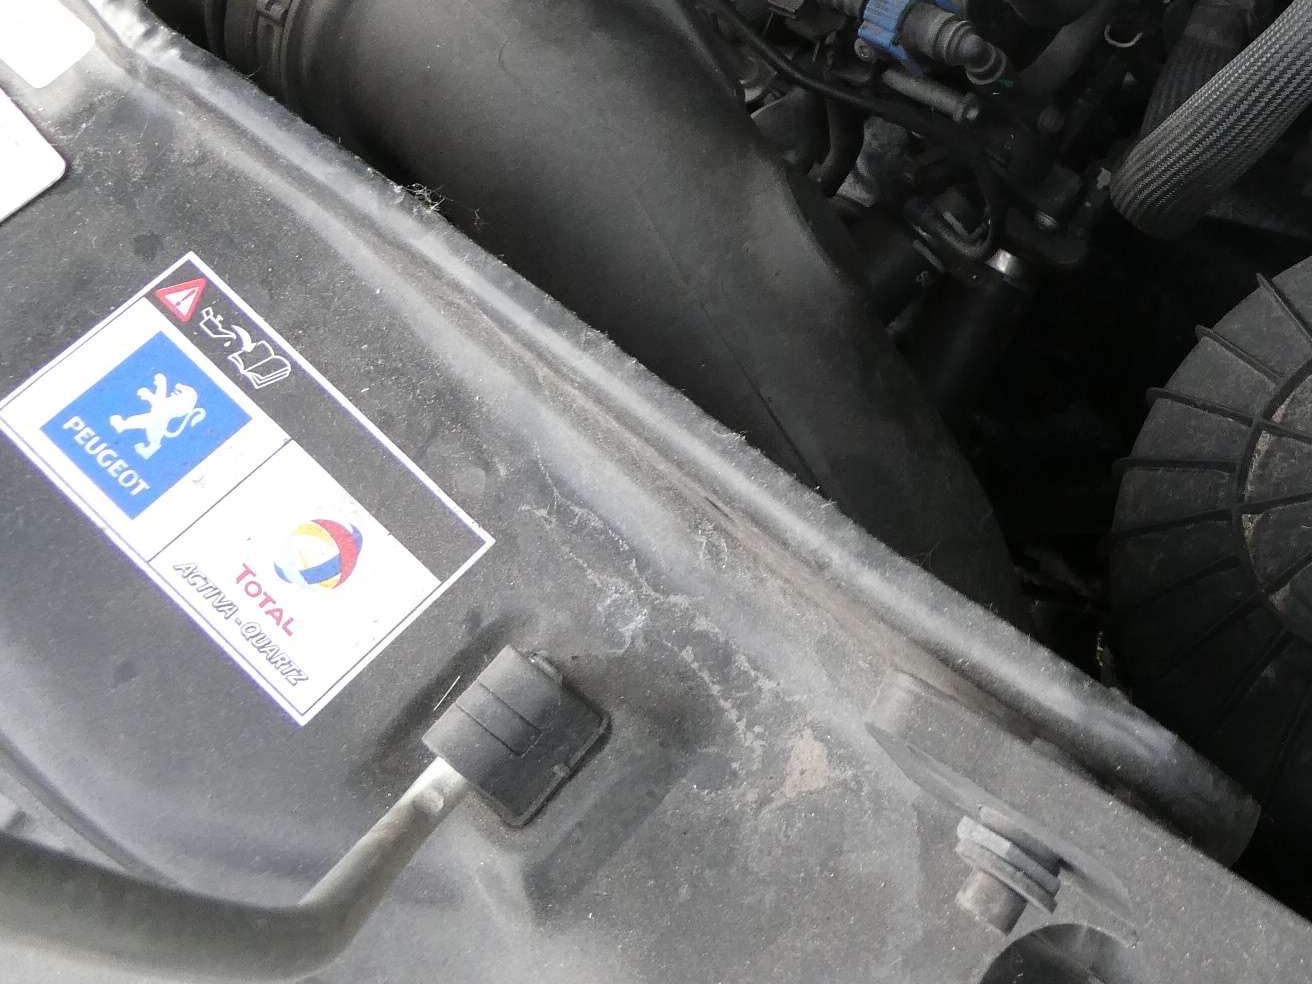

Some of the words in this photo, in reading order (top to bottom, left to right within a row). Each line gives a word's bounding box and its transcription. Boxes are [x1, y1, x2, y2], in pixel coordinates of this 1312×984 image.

[63, 416, 150, 496] PEUGEOT
[172, 562, 239, 619] ACTIVA
[240, 621, 309, 686] QUARTZ
[235, 563, 294, 636] TOTAL
